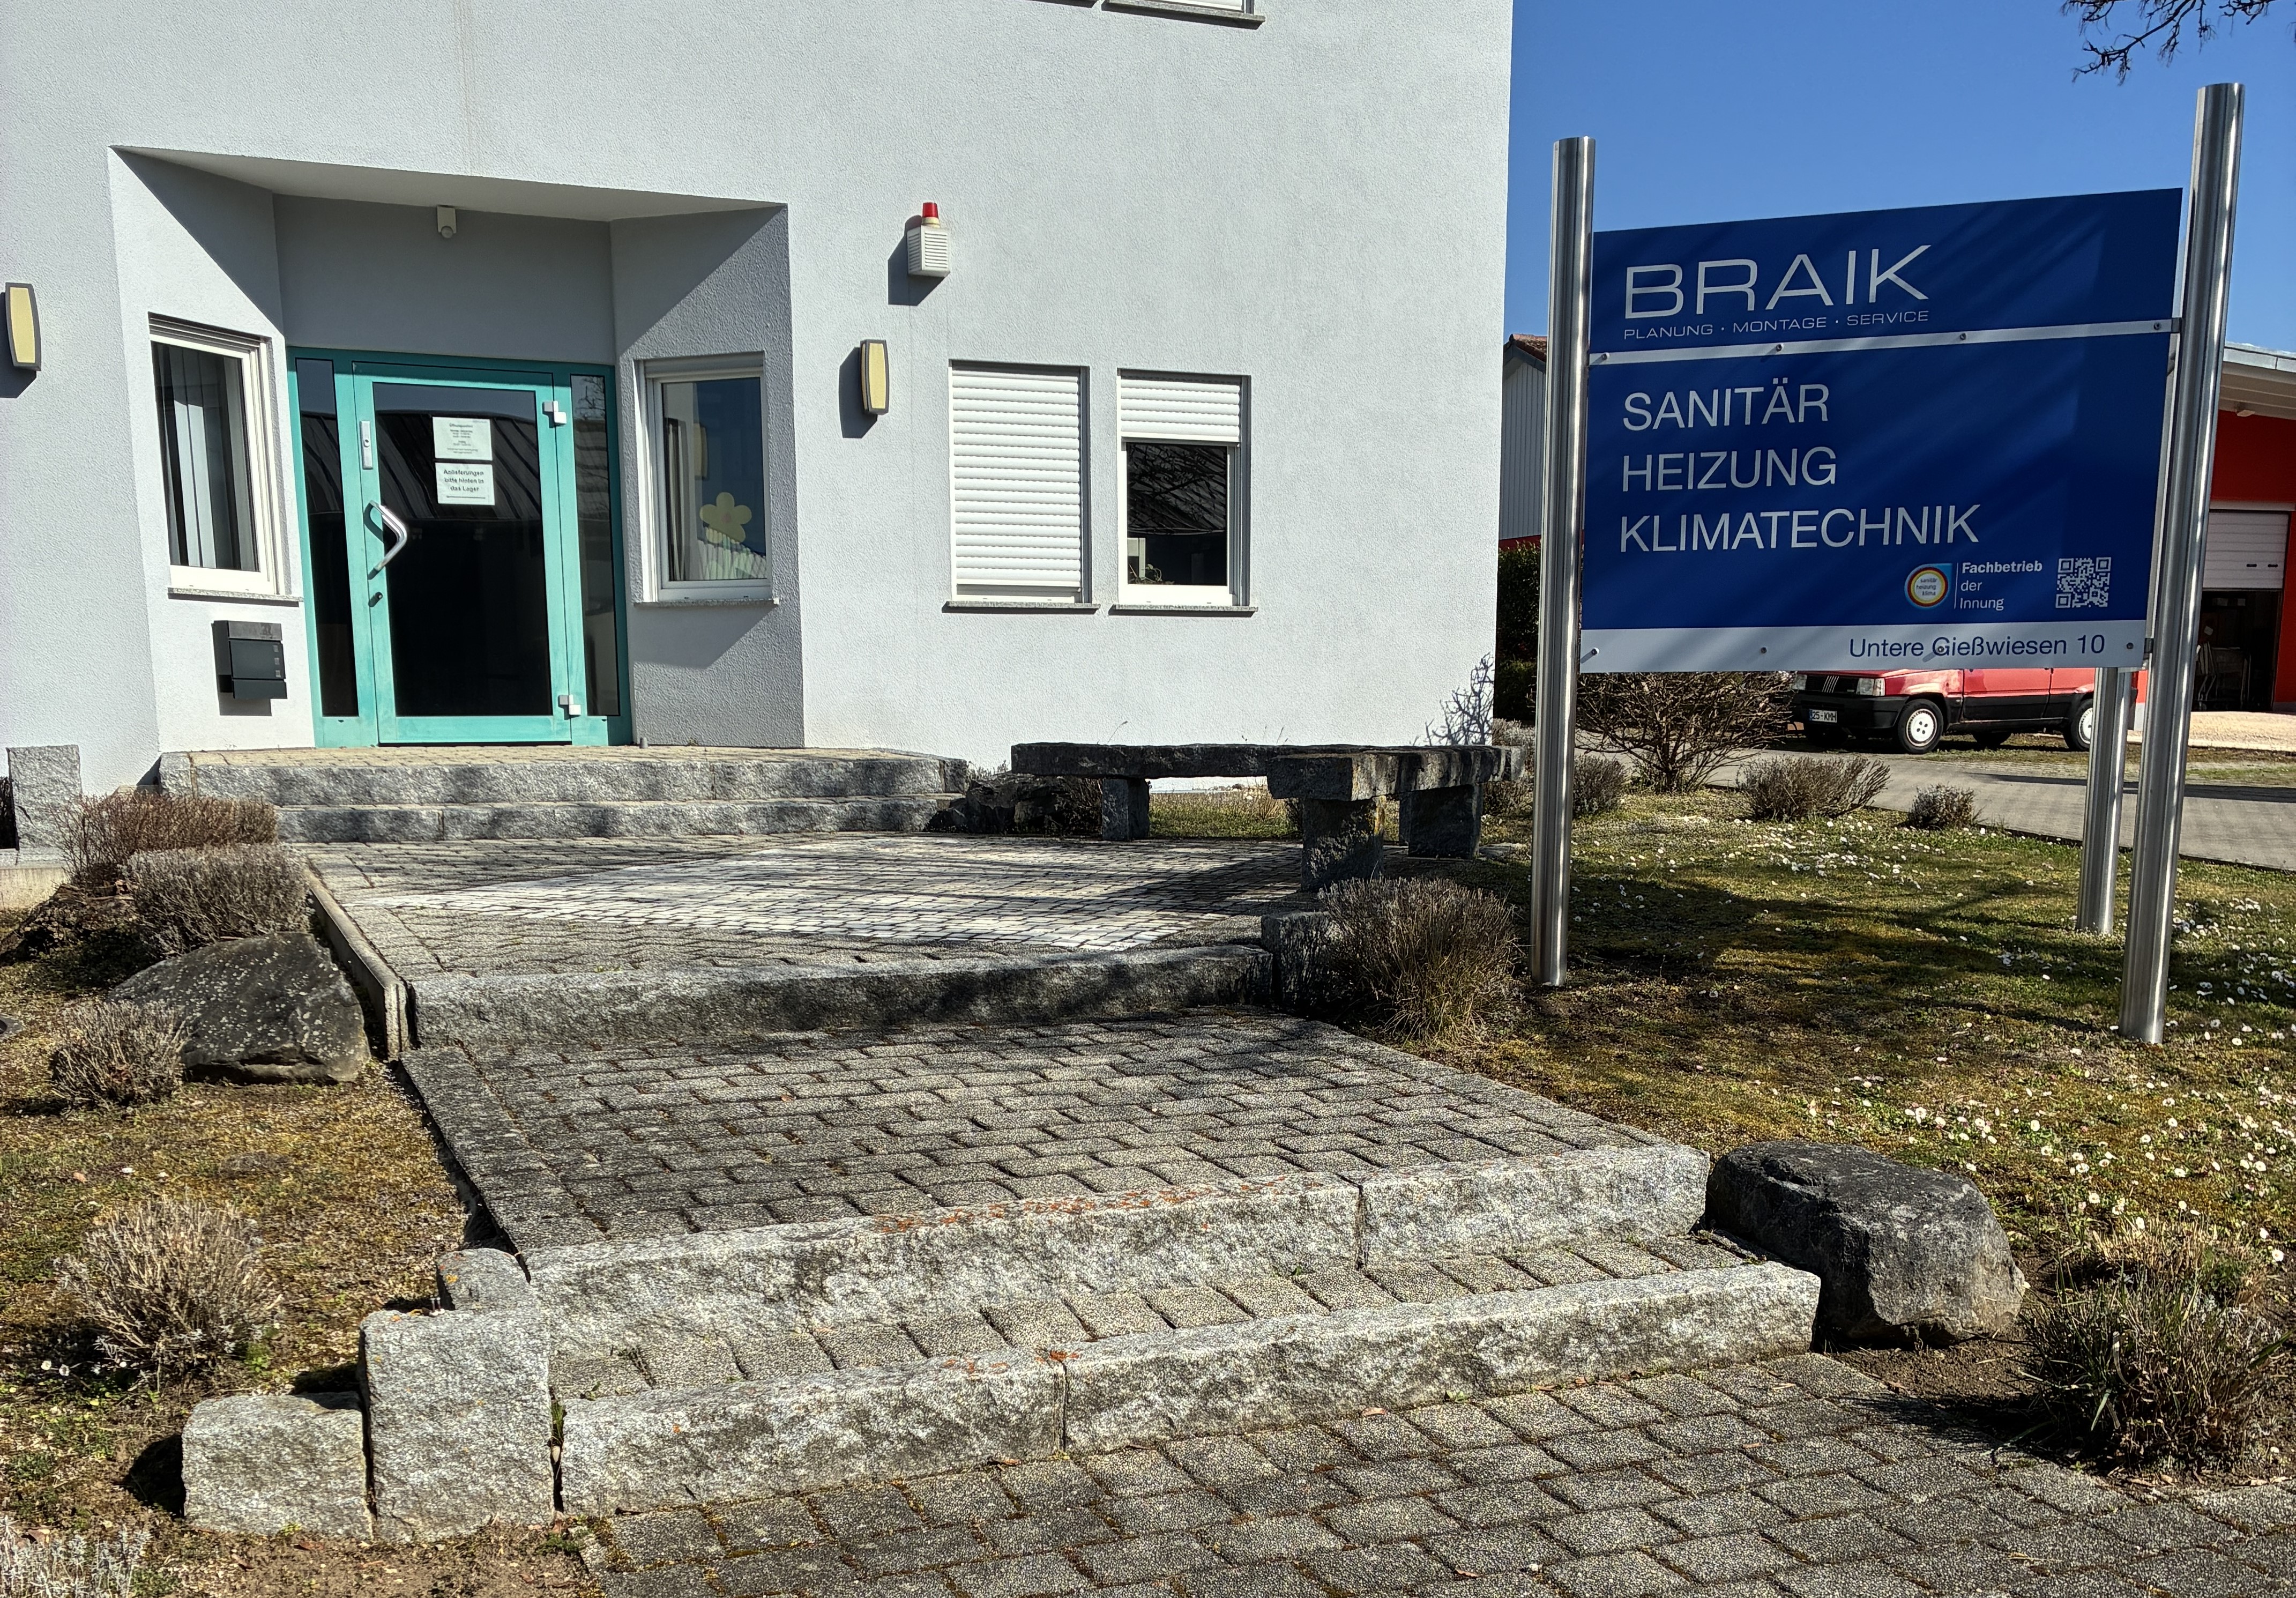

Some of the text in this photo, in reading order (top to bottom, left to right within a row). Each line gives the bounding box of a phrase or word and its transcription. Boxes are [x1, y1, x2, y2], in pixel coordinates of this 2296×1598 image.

[1624, 244, 1932, 319] BRAIK
[1624, 324, 1713, 340] PLANUNG
[1733, 317, 1827, 333] MONTAGE
[1847, 310, 1929, 326] SERVICE
[1622, 377, 1830, 431] SANITÄR
[1622, 446, 1837, 492] HEIZUNG
[1620, 504, 1981, 553] KLIMATECHNIK
[1962, 560, 2043, 574] Fachbetrieb
[1960, 580, 1982, 591] der
[1959, 597, 2004, 611] Innung
[1849, 634, 2105, 657] Untere Gießwiesen 10
